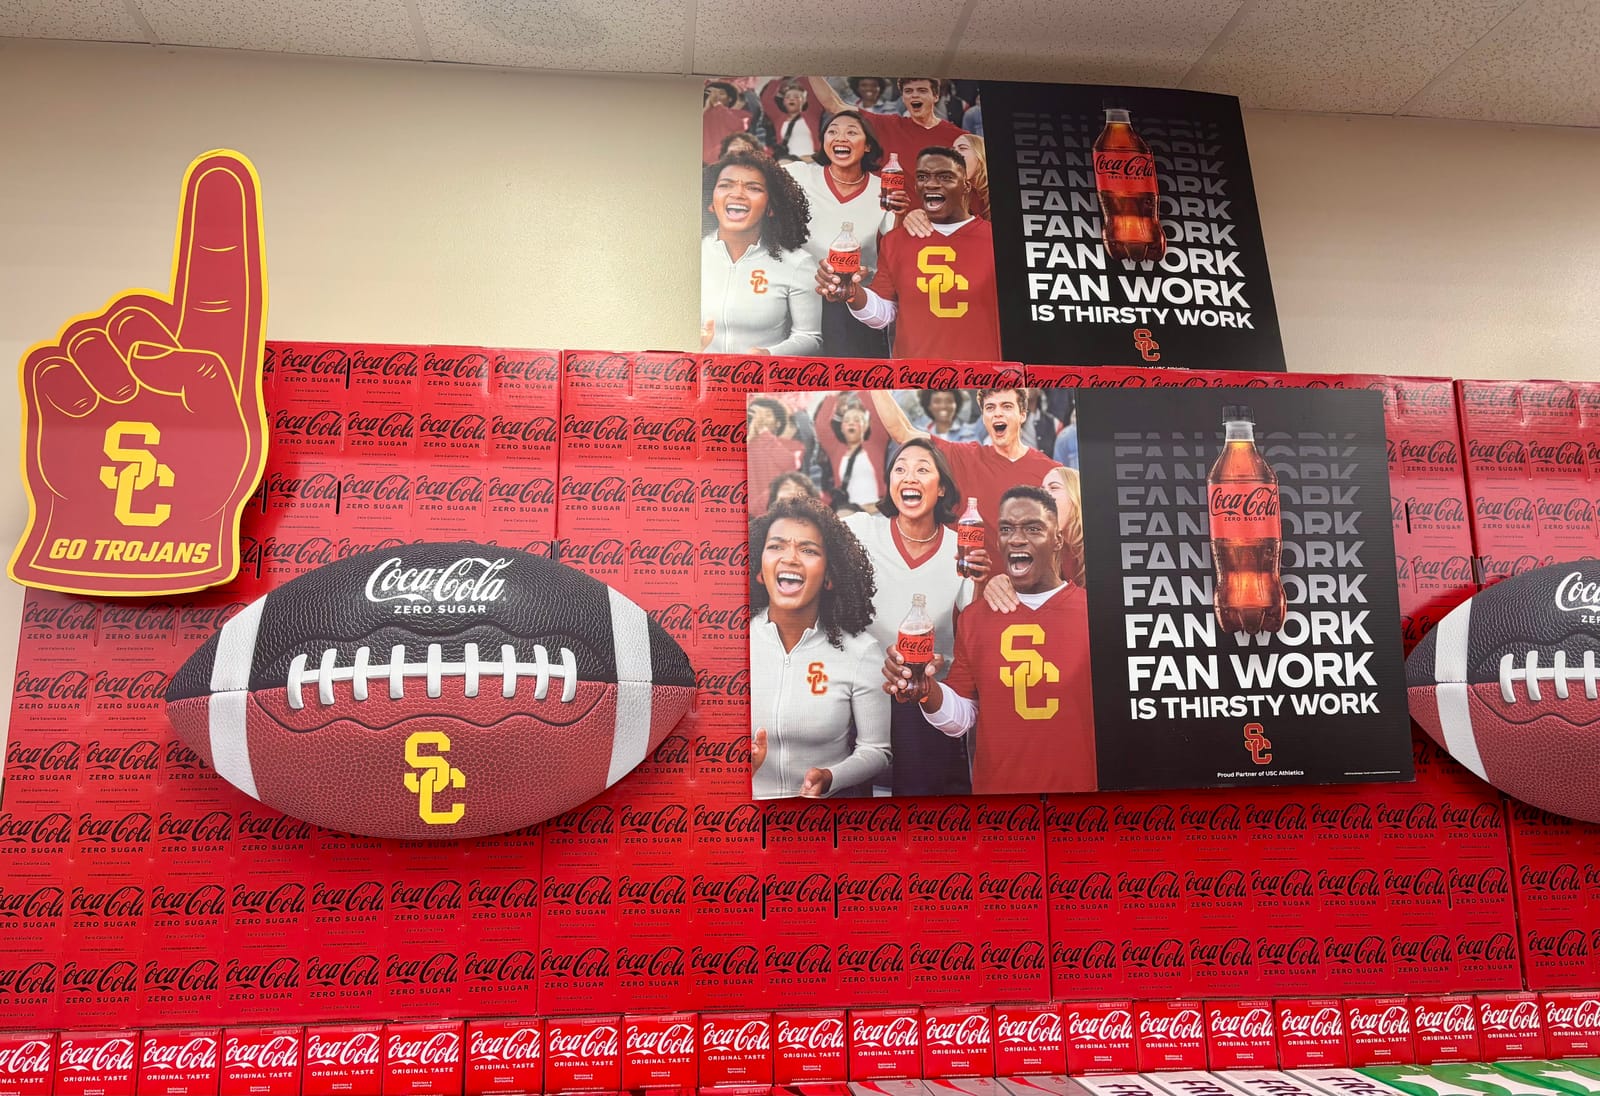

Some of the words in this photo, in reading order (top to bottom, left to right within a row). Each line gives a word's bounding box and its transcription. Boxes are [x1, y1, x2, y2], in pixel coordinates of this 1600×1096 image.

[1018, 168, 1096, 188] FAN
[1096, 154, 1153, 177] Coca-Cola
[1020, 189, 1100, 212] FAN
[1159, 195, 1233, 220] ORK
[1023, 214, 1102, 238] FAN
[1165, 219, 1238, 247] ORK
[1025, 241, 1107, 270] FAN
[750, 269, 768, 294] SC
[916, 246, 969, 318] SC
[1027, 273, 1111, 301] FAN
[1118, 276, 1251, 308] WORK
[1031, 304, 1055, 322] IS
[1058, 305, 1169, 325] THIRSTY
[1174, 308, 1255, 330] WORK
[1133, 328, 1160, 361] SC
[99, 421, 175, 527] SC
[1211, 487, 1277, 516] Coca-Cola
[1118, 511, 1209, 536] FAN
[49, 538, 86, 561] GO
[92, 539, 211, 564] TROJANS
[1120, 541, 1212, 570] FAN
[1281, 540, 1365, 568] ORK
[365, 557, 515, 602] Coca-Cola
[1122, 575, 1214, 607] FAN
[1282, 573, 1368, 604] ORK
[394, 605, 432, 614] ZERO
[438, 604, 486, 613] SUGAR
[1124, 612, 1217, 649] FAN
[806, 661, 829, 696] SC
[1000, 623, 1060, 720] SC
[1127, 654, 1219, 692] FAN
[1229, 651, 1378, 689] WORK
[1130, 697, 1158, 720] IS
[1161, 694, 1285, 719] THIRSTY
[1289, 691, 1382, 716] WORK
[1243, 722, 1273, 765] SC
[404, 731, 465, 825] SC
[468, 985, 493, 993] ZERO
